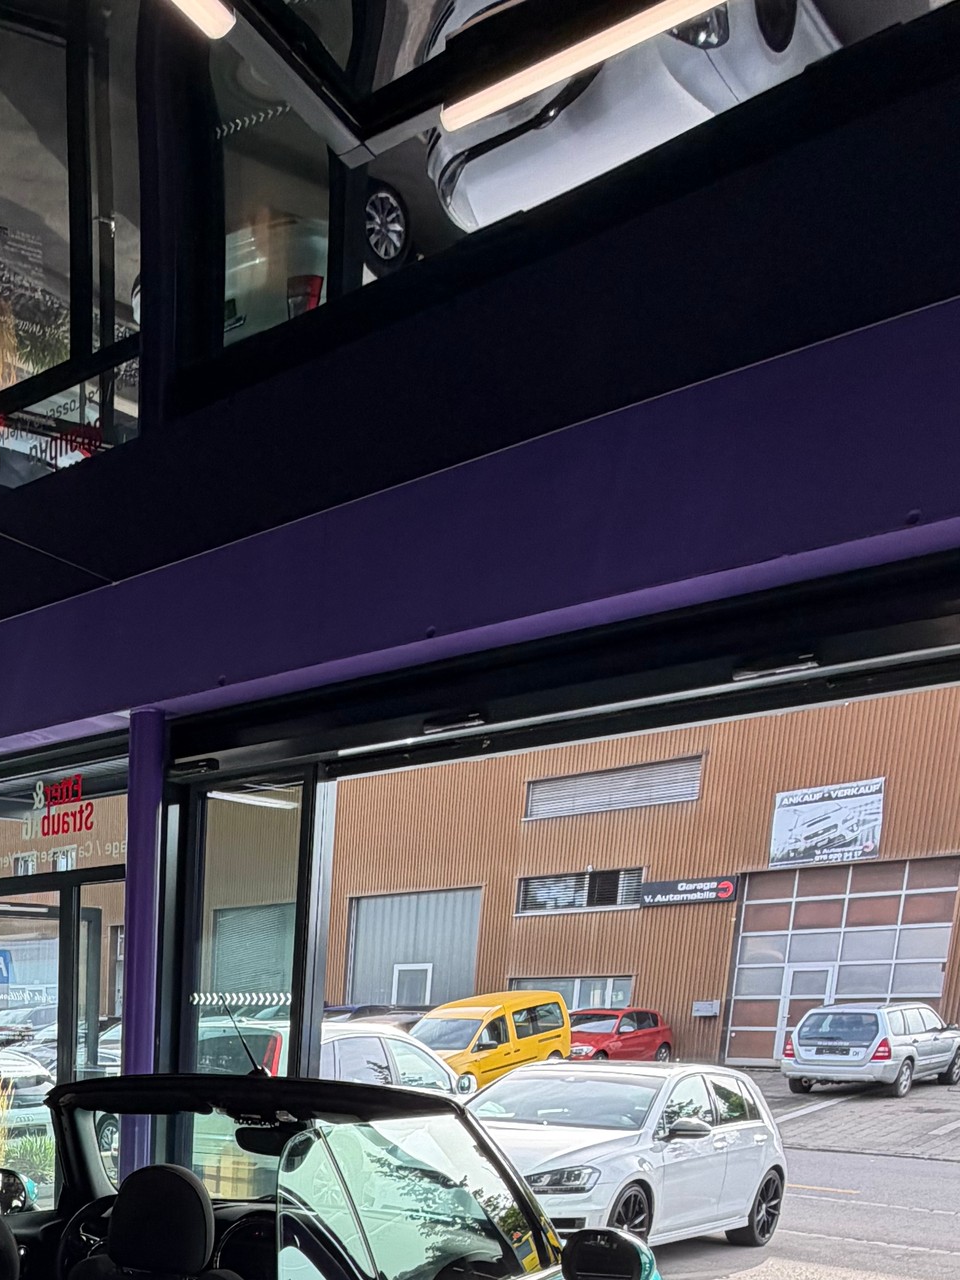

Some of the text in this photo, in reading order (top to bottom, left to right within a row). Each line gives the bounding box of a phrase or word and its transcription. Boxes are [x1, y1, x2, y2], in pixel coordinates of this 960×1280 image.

[781, 783, 881, 806] ANKAUF VERKAUF
[677, 882, 718, 891] Garage
